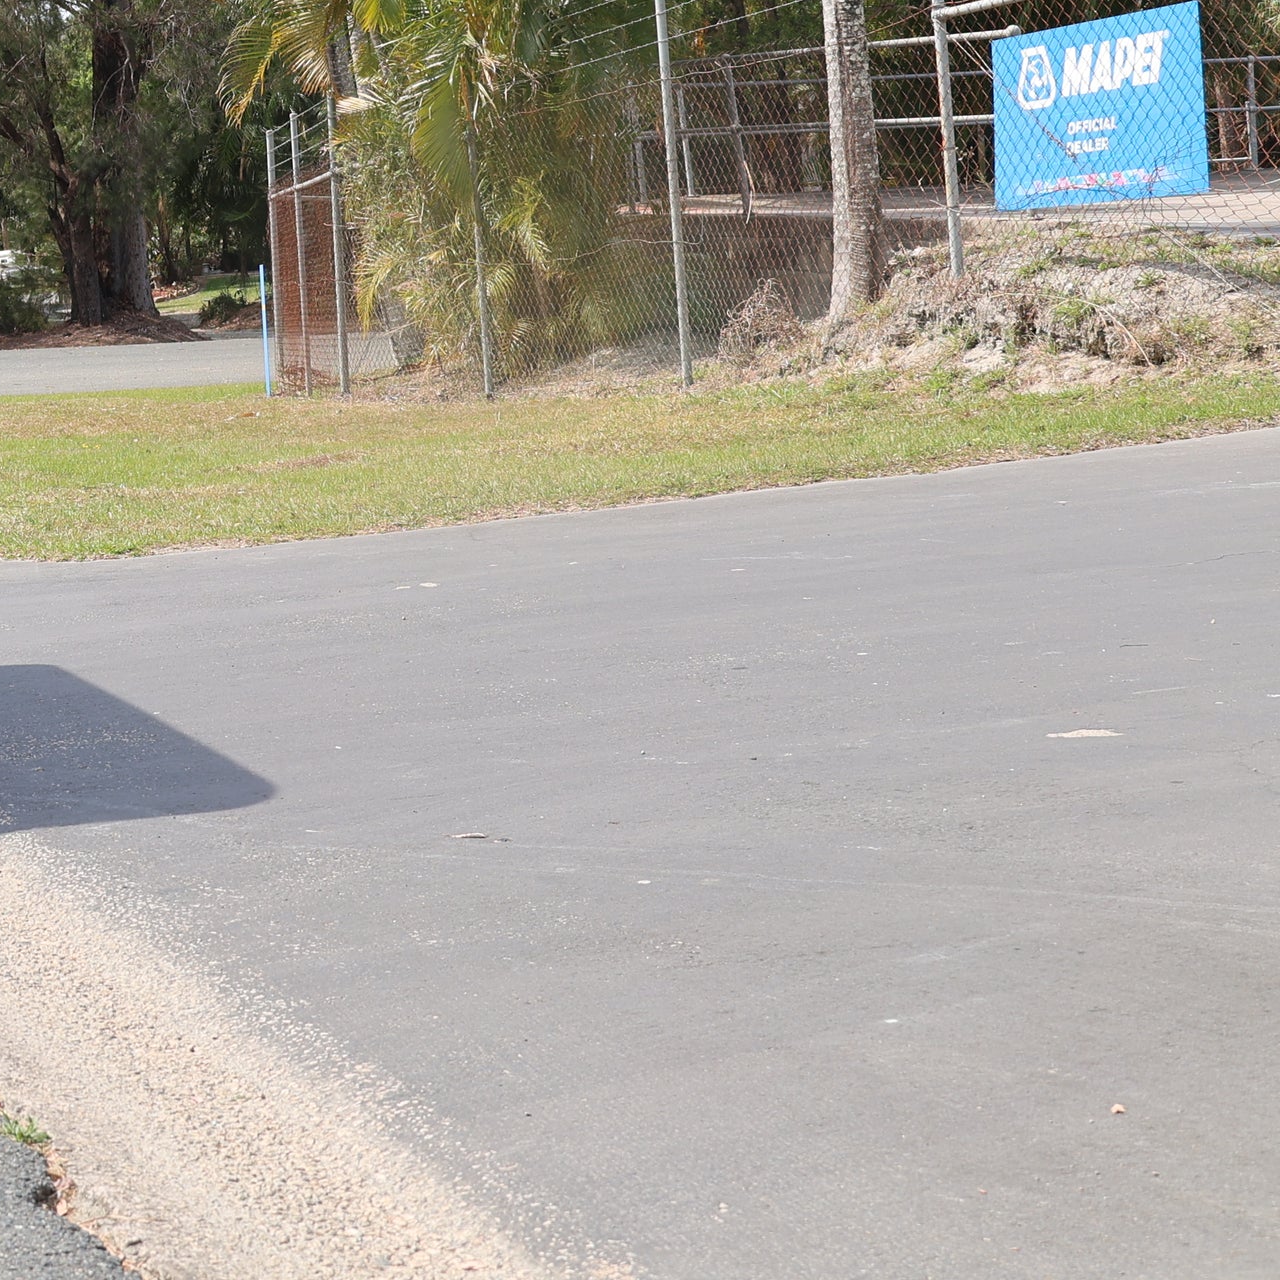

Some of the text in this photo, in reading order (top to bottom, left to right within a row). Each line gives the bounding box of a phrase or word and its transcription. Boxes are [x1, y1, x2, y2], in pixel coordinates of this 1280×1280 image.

[1061, 30, 1164, 97] MAPEI
[1067, 116, 1117, 134] OFFICIAL
[1066, 137, 1109, 155] DEALER
